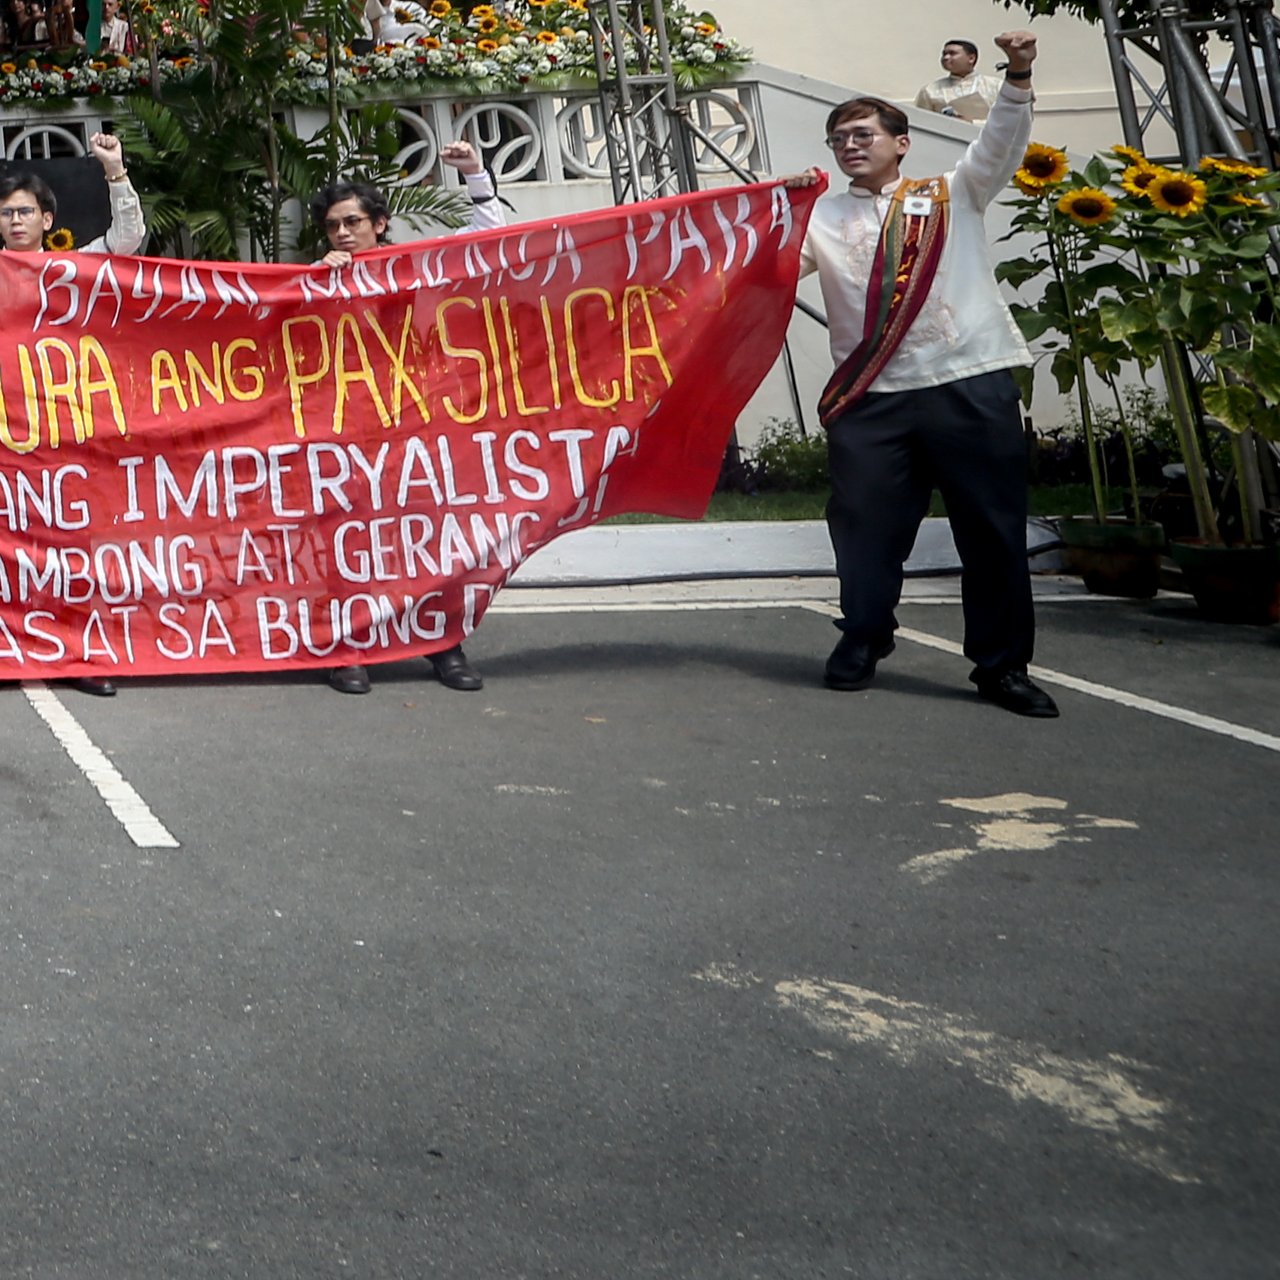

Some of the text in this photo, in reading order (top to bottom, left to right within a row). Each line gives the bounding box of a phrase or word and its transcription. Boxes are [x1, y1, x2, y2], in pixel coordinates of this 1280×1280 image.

[149, 337, 267, 416] ANG
[281, 300, 433, 440] PAX
[435, 285, 675, 426] SILICA
[237, 522, 300, 587] AT
[83, 606, 139, 665] AT
[155, 598, 238, 661] SA
[255, 591, 448, 662] BUONG
